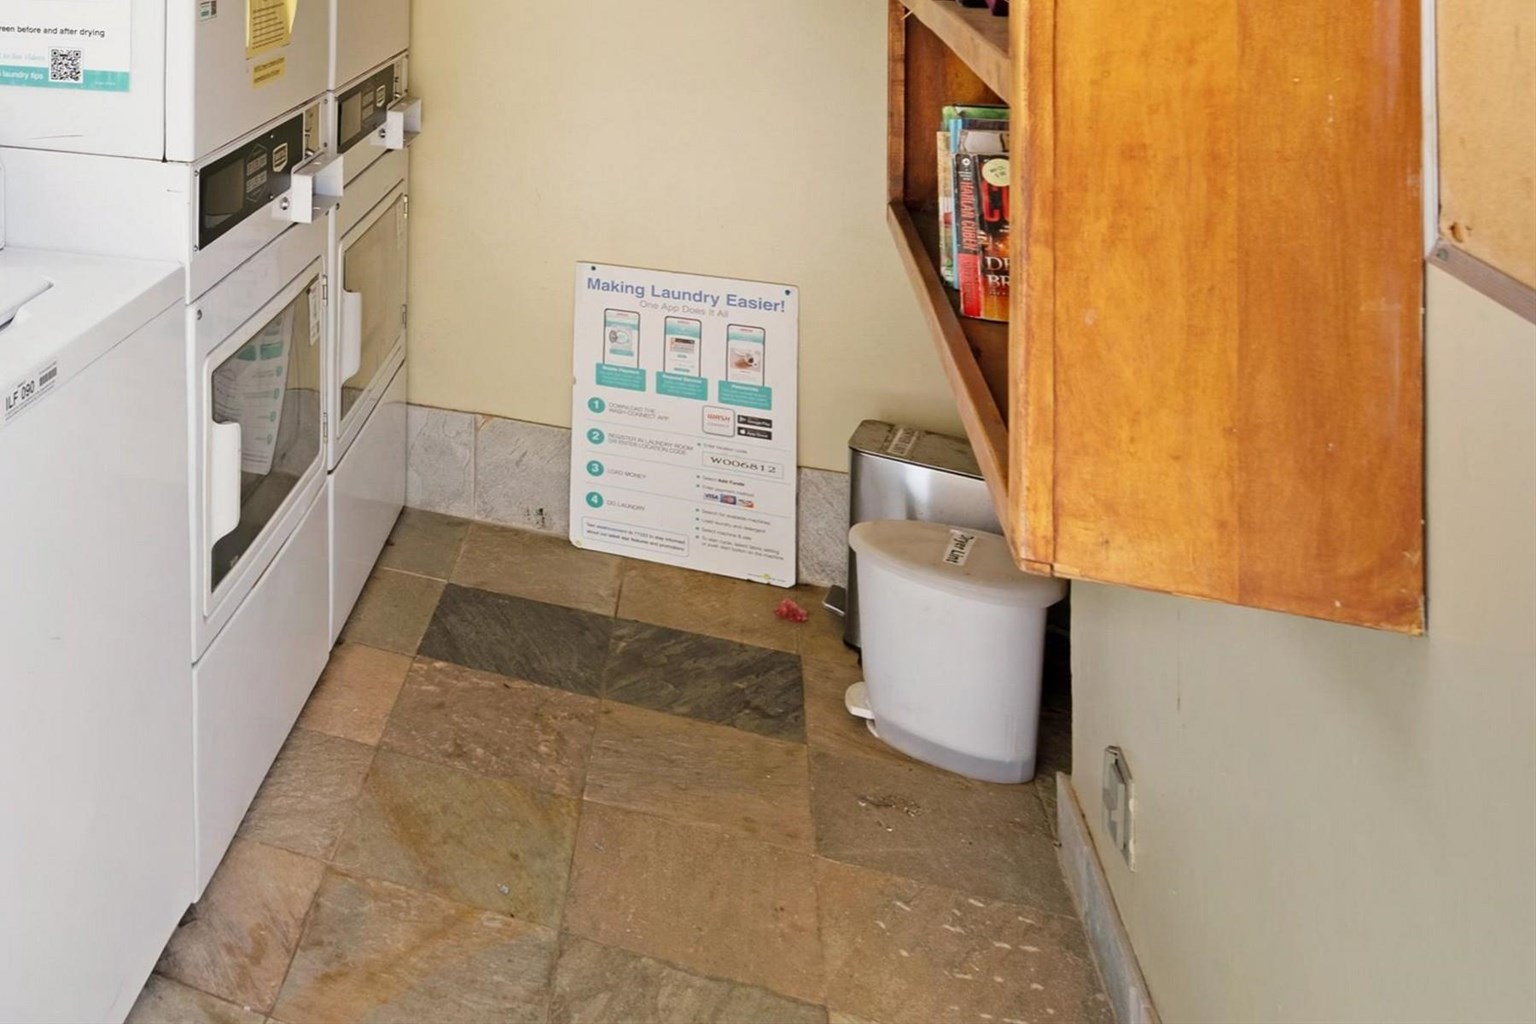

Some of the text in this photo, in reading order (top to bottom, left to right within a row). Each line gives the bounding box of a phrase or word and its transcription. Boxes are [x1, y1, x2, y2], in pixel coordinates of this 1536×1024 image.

[17, 26, 41, 34] before
[43, 27, 58, 35] and
[60, 28, 77, 36] after
[80, 28, 105, 38] drying
[587, 278, 785, 312] Making Laundry Easier!
[640, 300, 658, 309] One
[661, 303, 679, 312] App
[682, 306, 705, 315] Does
[717, 310, 728, 318] All
[6, 391, 18, 411] ILF
[21, 380, 35, 399] 090
[593, 401, 599, 409] 1
[592, 432, 600, 440] 2
[592, 463, 599, 472] 3
[711, 457, 776, 474] W006812
[591, 495, 598, 503] 4
